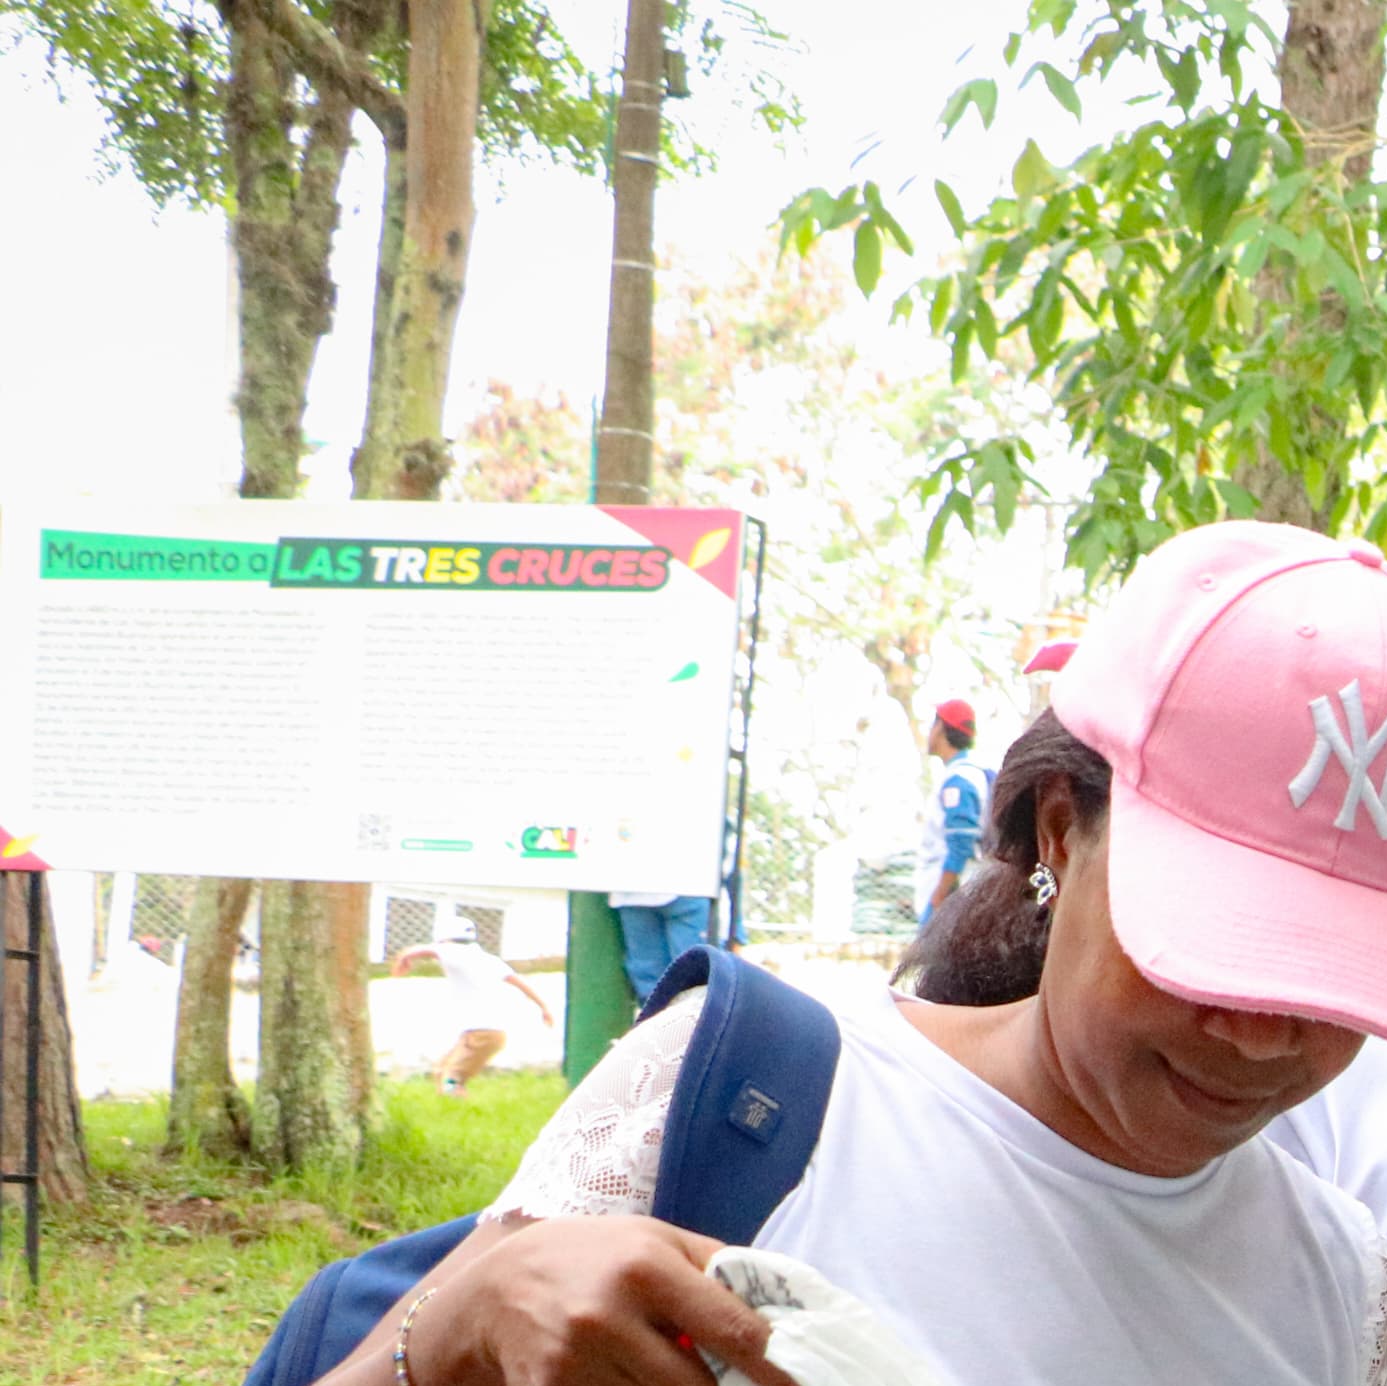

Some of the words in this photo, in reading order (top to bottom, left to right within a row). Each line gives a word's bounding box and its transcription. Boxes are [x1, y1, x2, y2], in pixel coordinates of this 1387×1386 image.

[45, 541, 241, 574] Monumento
[249, 551, 268, 573] a
[277, 545, 363, 582] LAS
[368, 546, 482, 585] TRES
[486, 546, 669, 588] CRUCES
